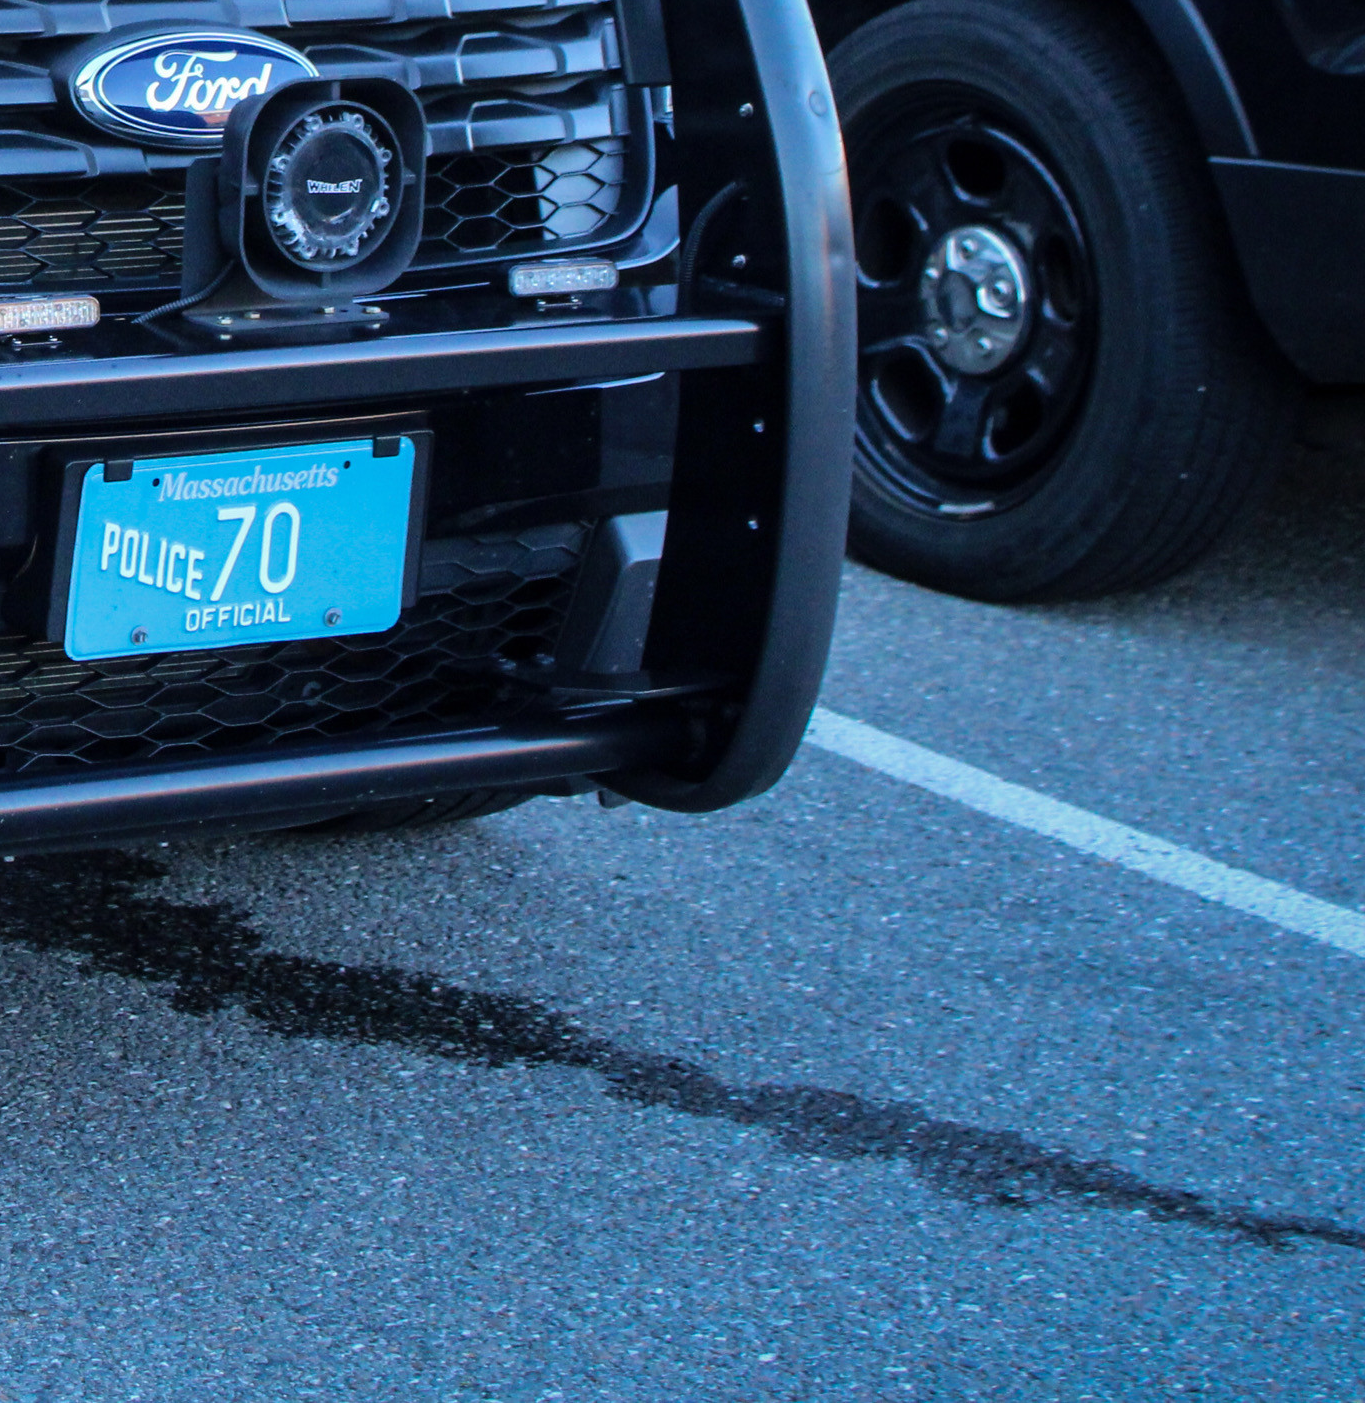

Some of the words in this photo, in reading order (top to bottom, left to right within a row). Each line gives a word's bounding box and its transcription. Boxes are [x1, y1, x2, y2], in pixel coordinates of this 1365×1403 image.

[145, 49, 272, 112] Ford
[158, 463, 339, 502] Massachusetts
[100, 521, 205, 601] POLICE
[209, 501, 301, 602] 70
[185, 599, 291, 633] OFFICIAL
